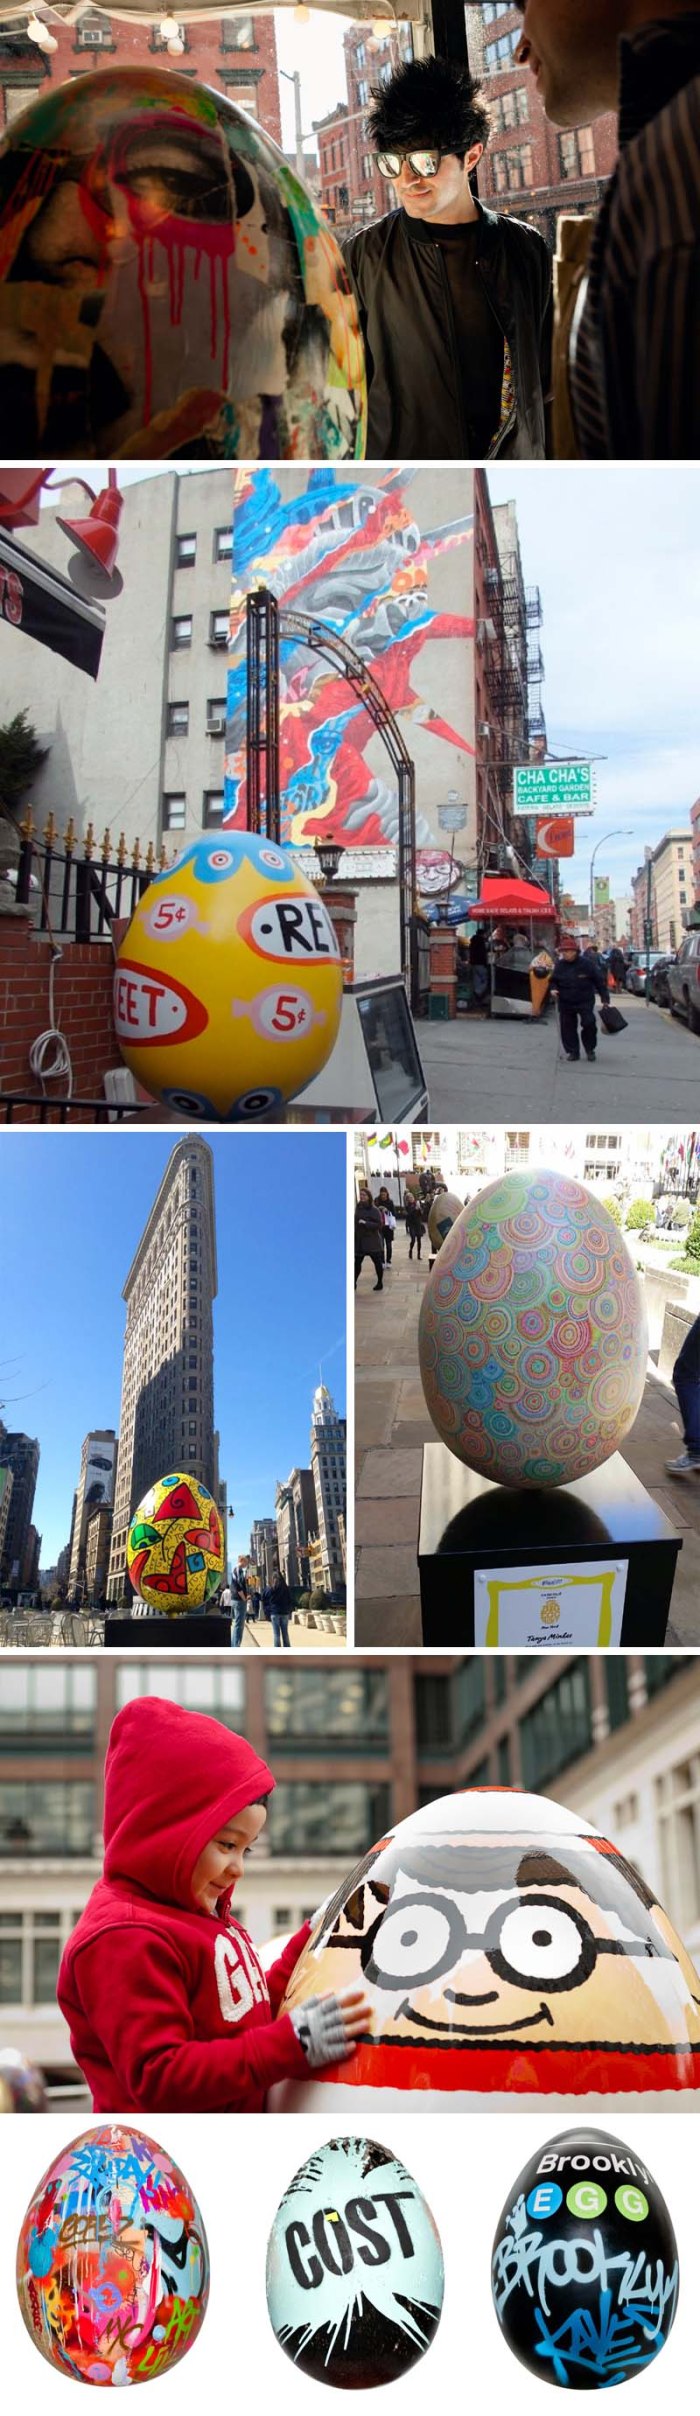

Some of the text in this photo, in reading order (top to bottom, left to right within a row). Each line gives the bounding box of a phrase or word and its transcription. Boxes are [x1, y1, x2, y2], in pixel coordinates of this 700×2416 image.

[517, 767, 589, 785] CHA CHA'S
[517, 783, 589, 794] BACKYARD GARDEN
[517, 792, 589, 804] CAFE & BAR
[275, 902, 337, 953] RE
[117, 978, 166, 1027] EET
[536, 2153, 656, 2186] Brookly
[285, 2191, 415, 2290] COST
